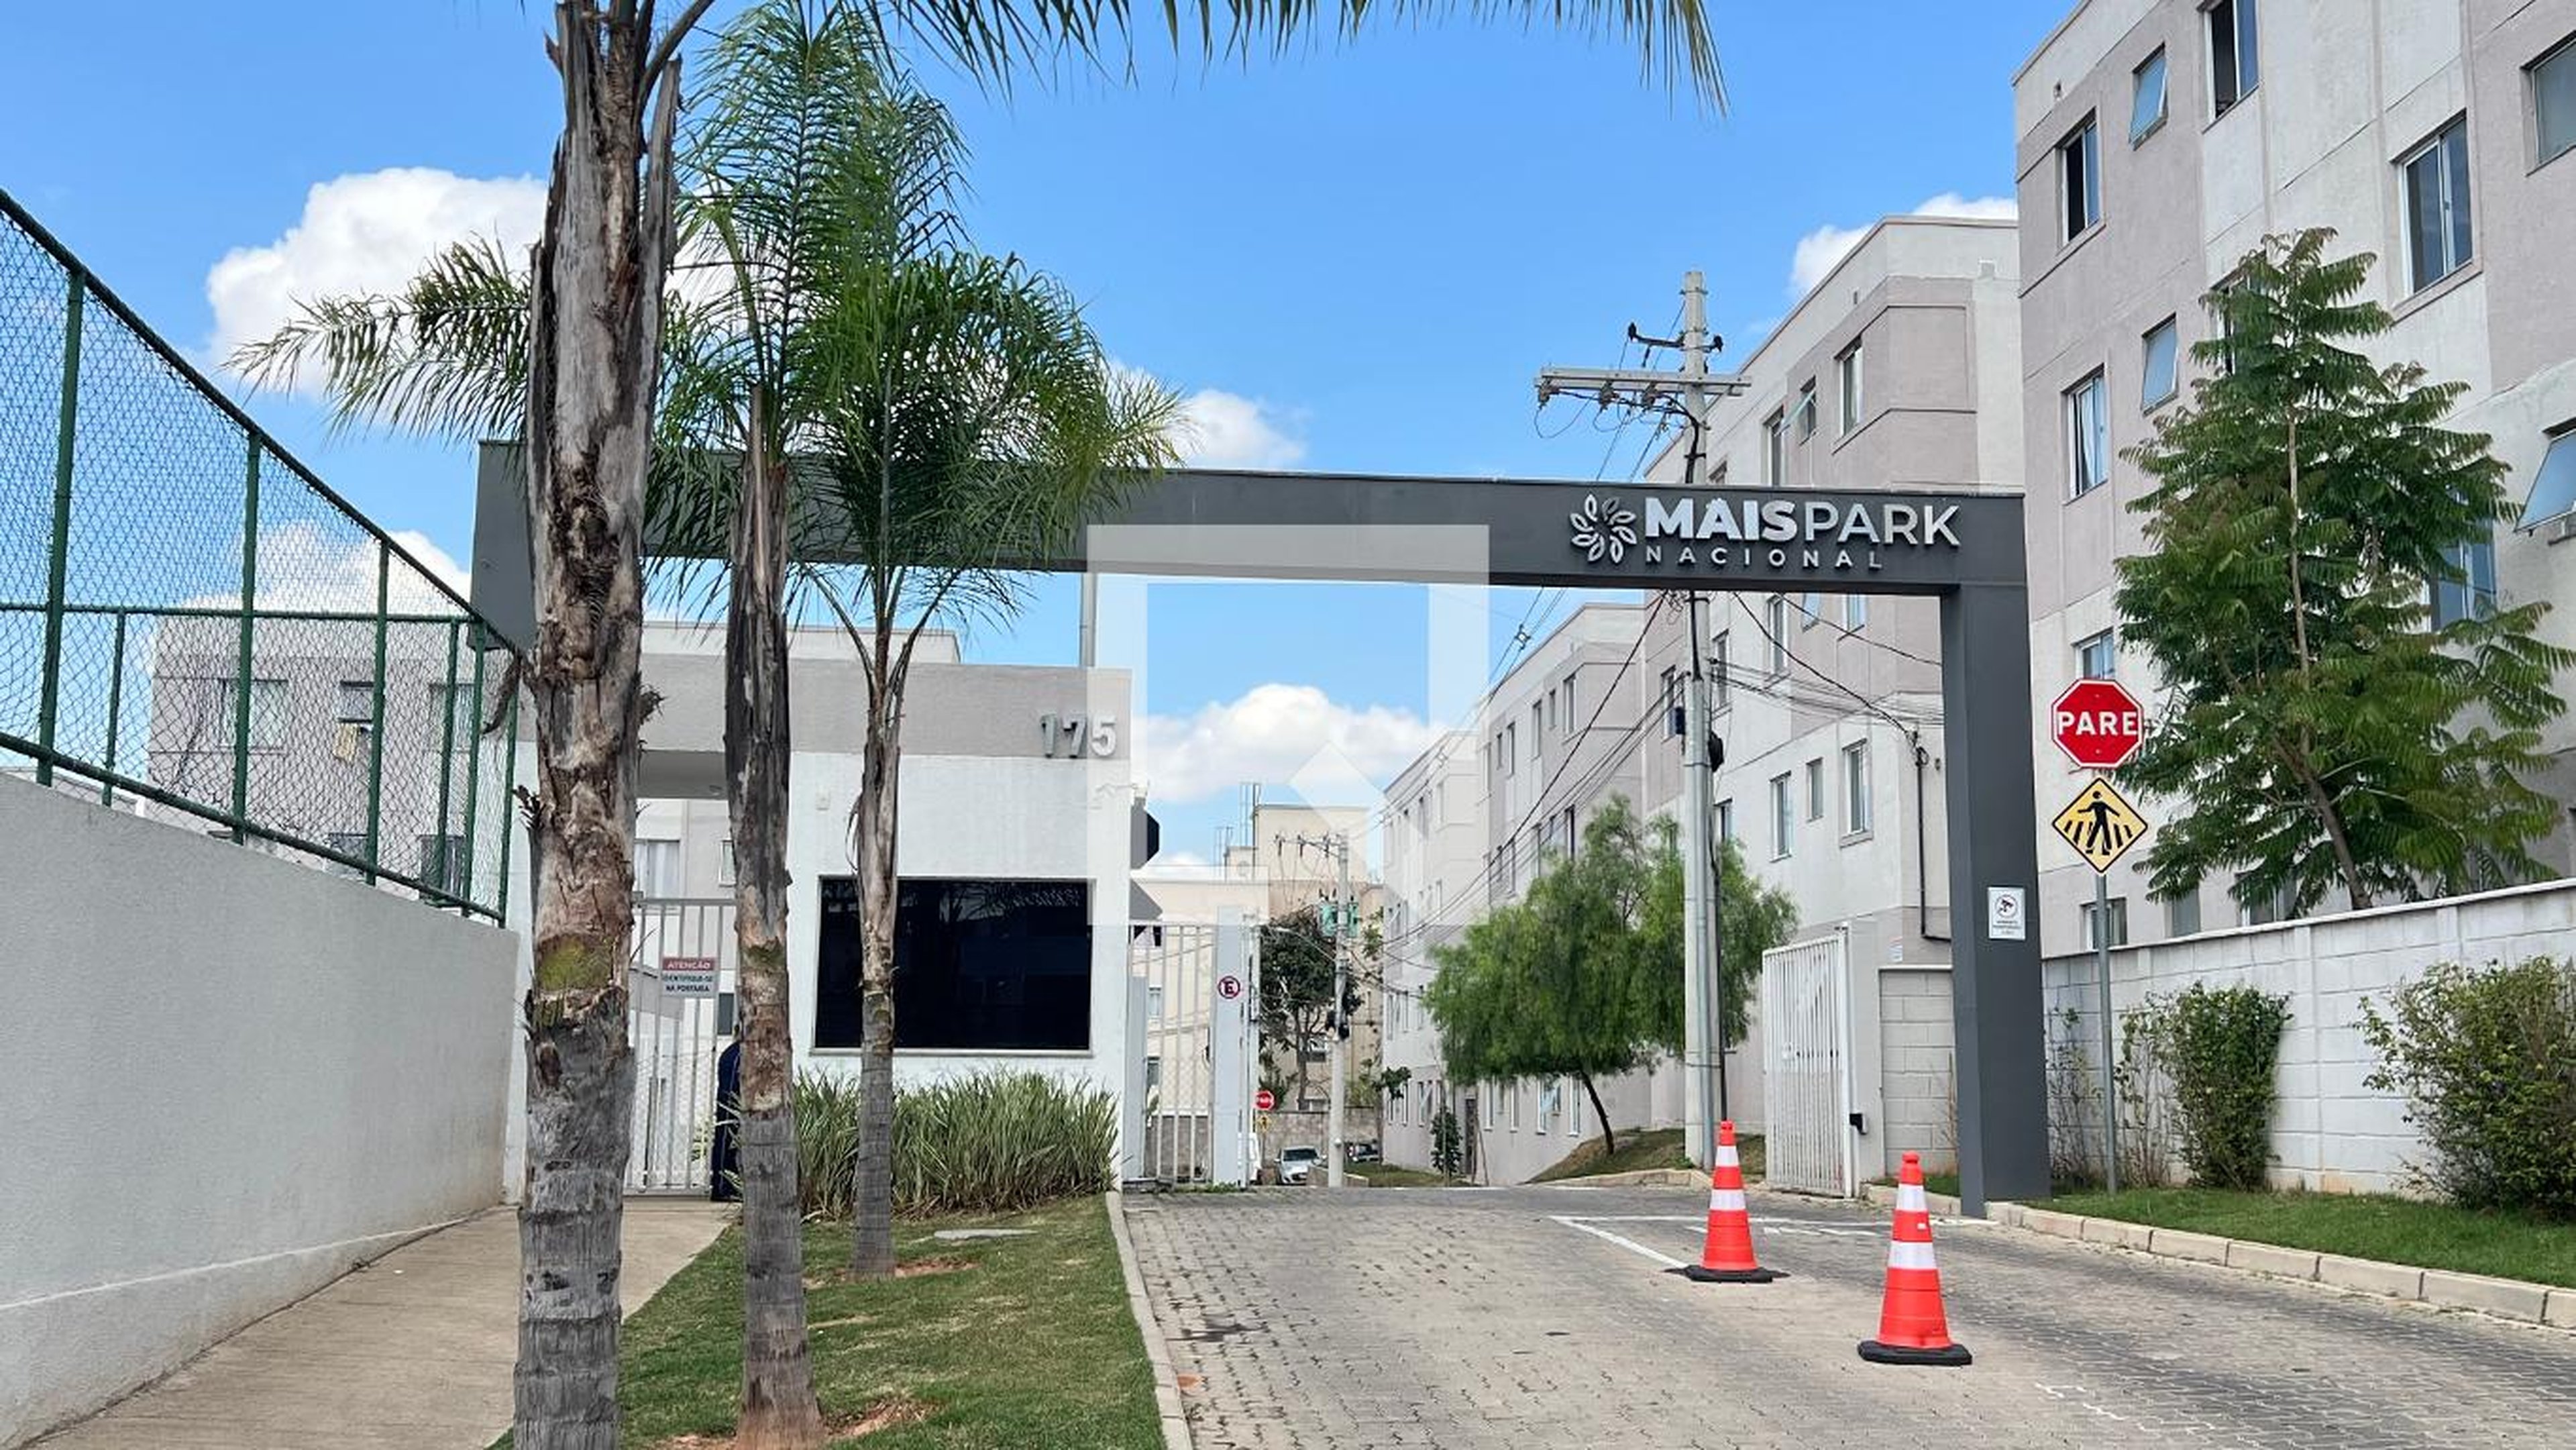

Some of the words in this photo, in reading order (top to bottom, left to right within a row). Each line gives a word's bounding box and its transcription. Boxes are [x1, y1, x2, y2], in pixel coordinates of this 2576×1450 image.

[1646, 545, 1882, 568] NACIONAL
[1040, 713, 1116, 758] 175
[2057, 711, 2138, 736] PARE
